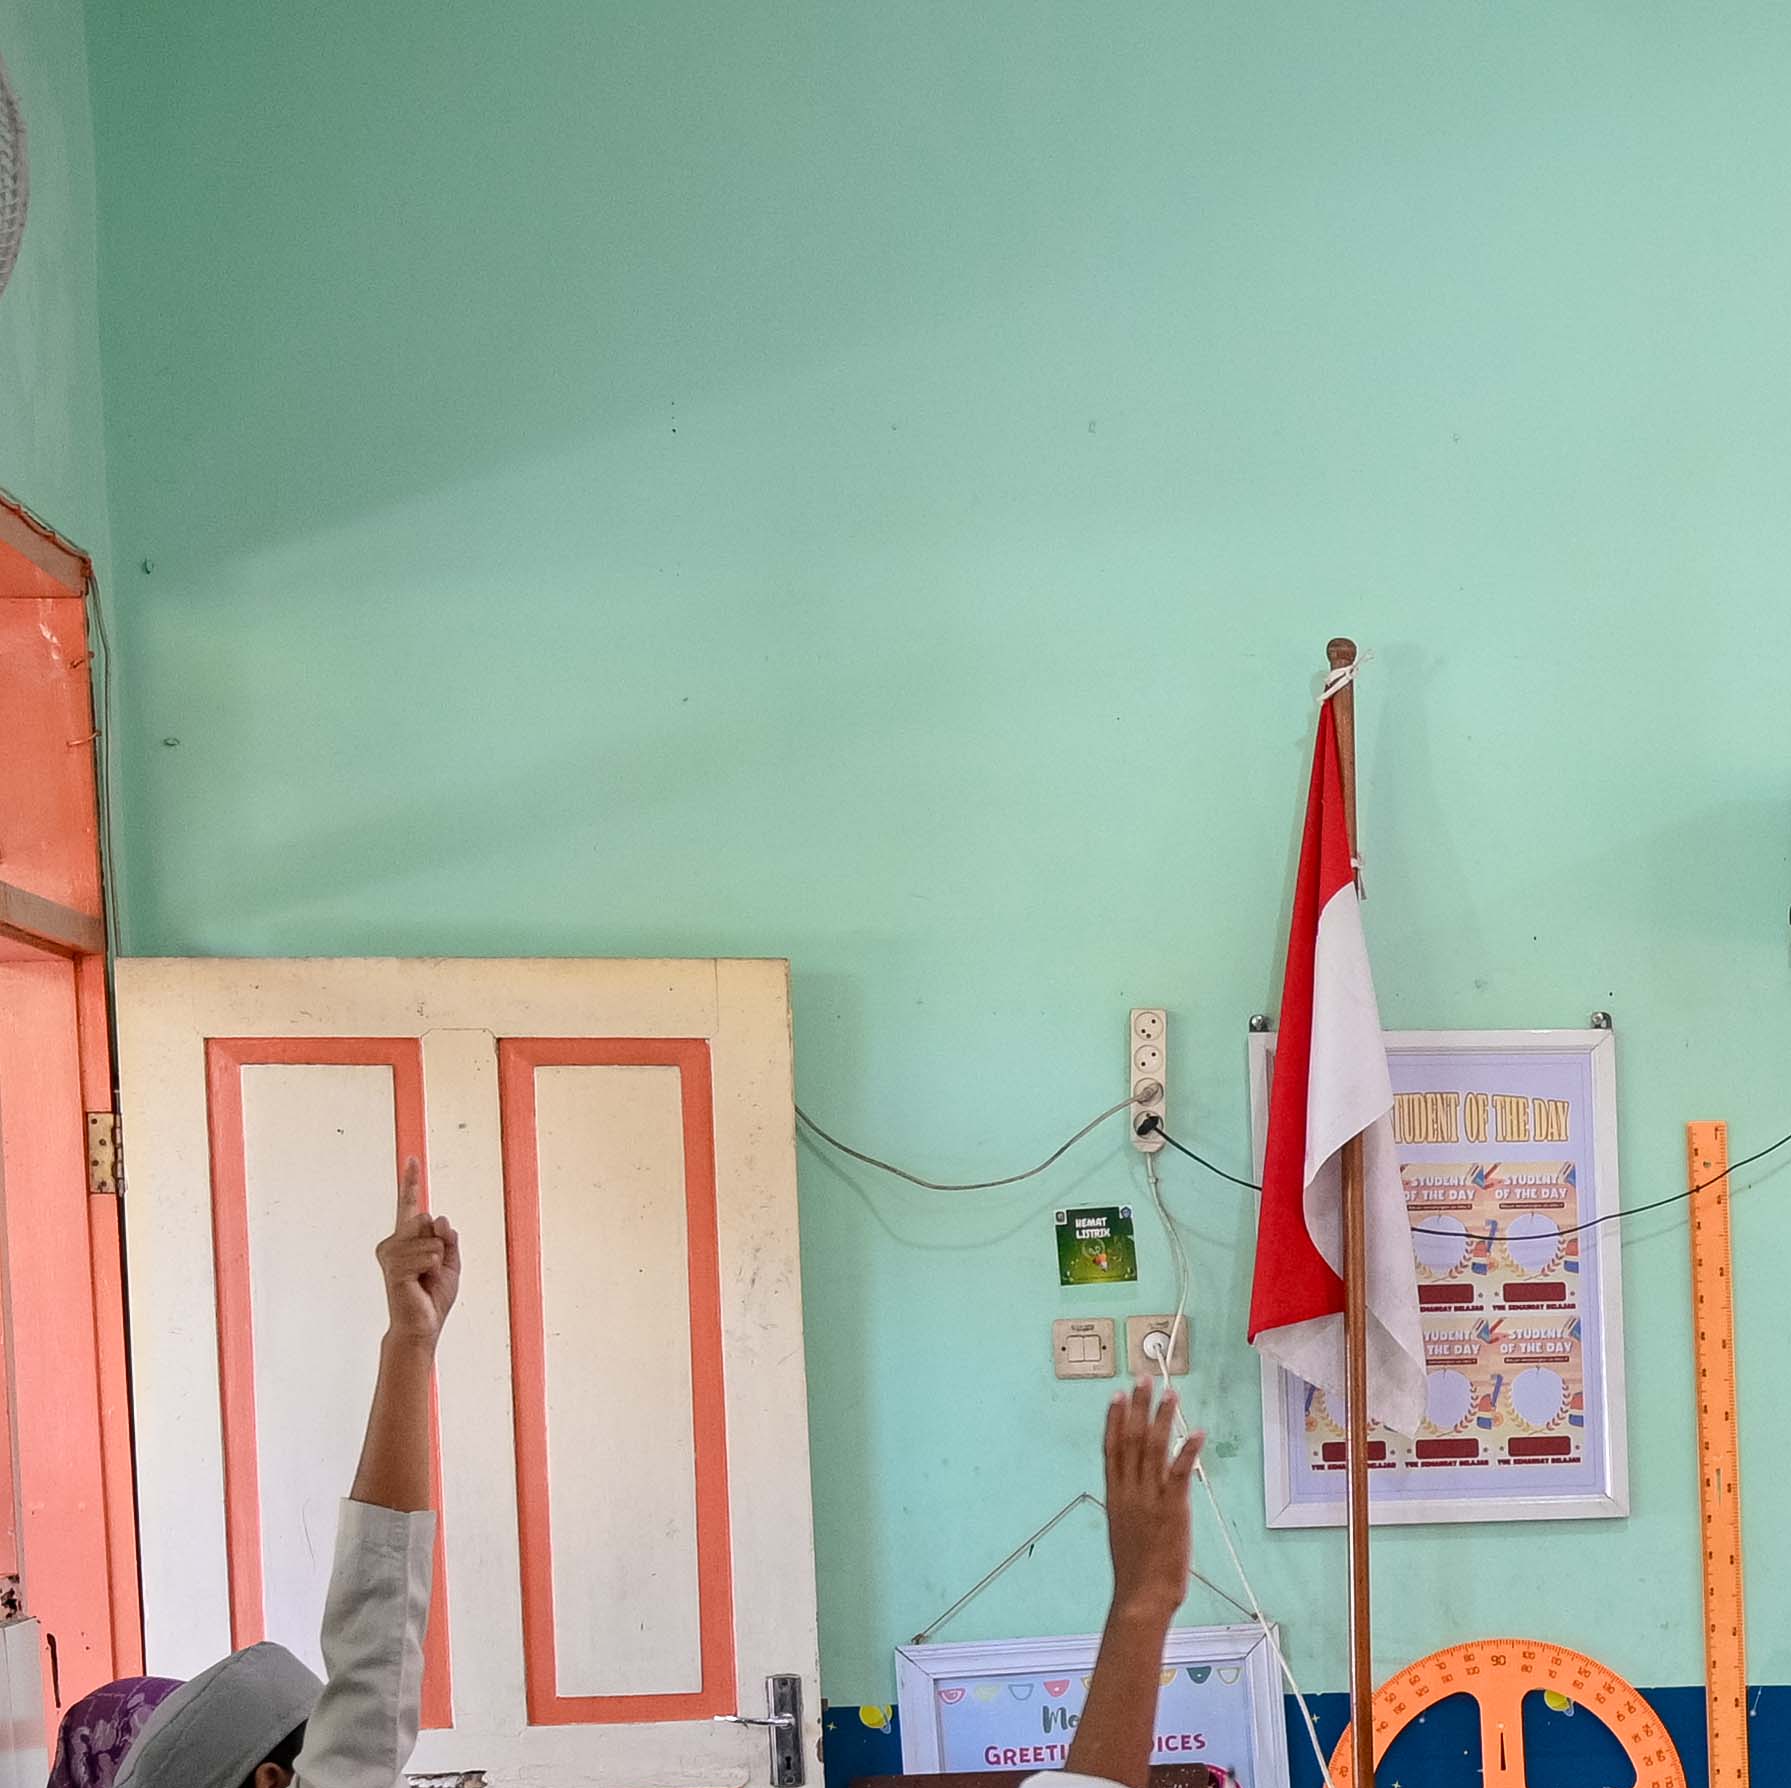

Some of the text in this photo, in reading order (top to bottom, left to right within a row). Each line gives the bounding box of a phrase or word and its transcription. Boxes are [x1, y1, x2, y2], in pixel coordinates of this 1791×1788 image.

[1393, 1092, 1570, 1144] TUDENT OF THE DAY
[1504, 1175, 1558, 1186] STUDENT
[1404, 1190, 1476, 1202] OF THE DAY
[1495, 1188, 1568, 1200] OF THE DAY
[1075, 1217, 1108, 1229] HEMAT
[1076, 1228, 1111, 1240] LISTRIK
[1424, 1330, 1472, 1342] TUDENT
[1508, 1328, 1562, 1340] STUDENT
[1427, 1343, 1481, 1355] THE DAY
[1500, 1342, 1573, 1354] OF THE DAY
[984, 1733, 1206, 1767] GREETI ICES
